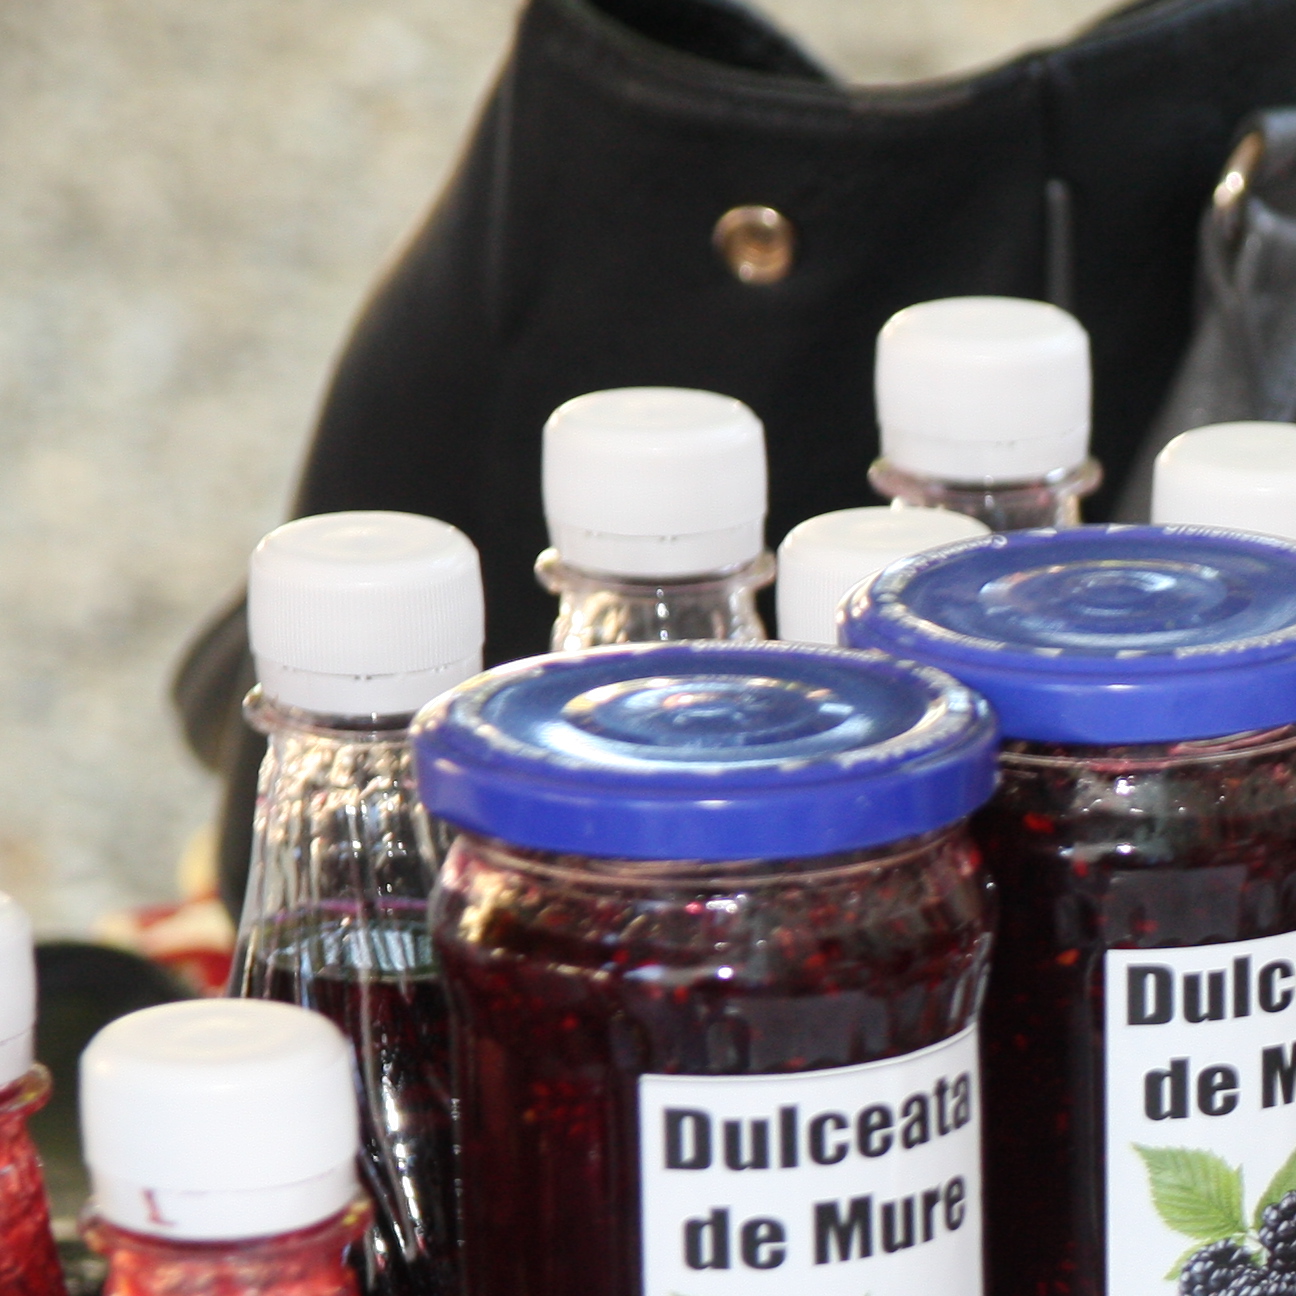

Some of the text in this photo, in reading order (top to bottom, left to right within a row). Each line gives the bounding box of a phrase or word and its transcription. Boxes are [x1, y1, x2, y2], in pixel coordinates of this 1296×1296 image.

[662, 1069, 972, 1172] Dulceata
[1143, 1056, 1241, 1121] de
[682, 1174, 966, 1271] de Mure
